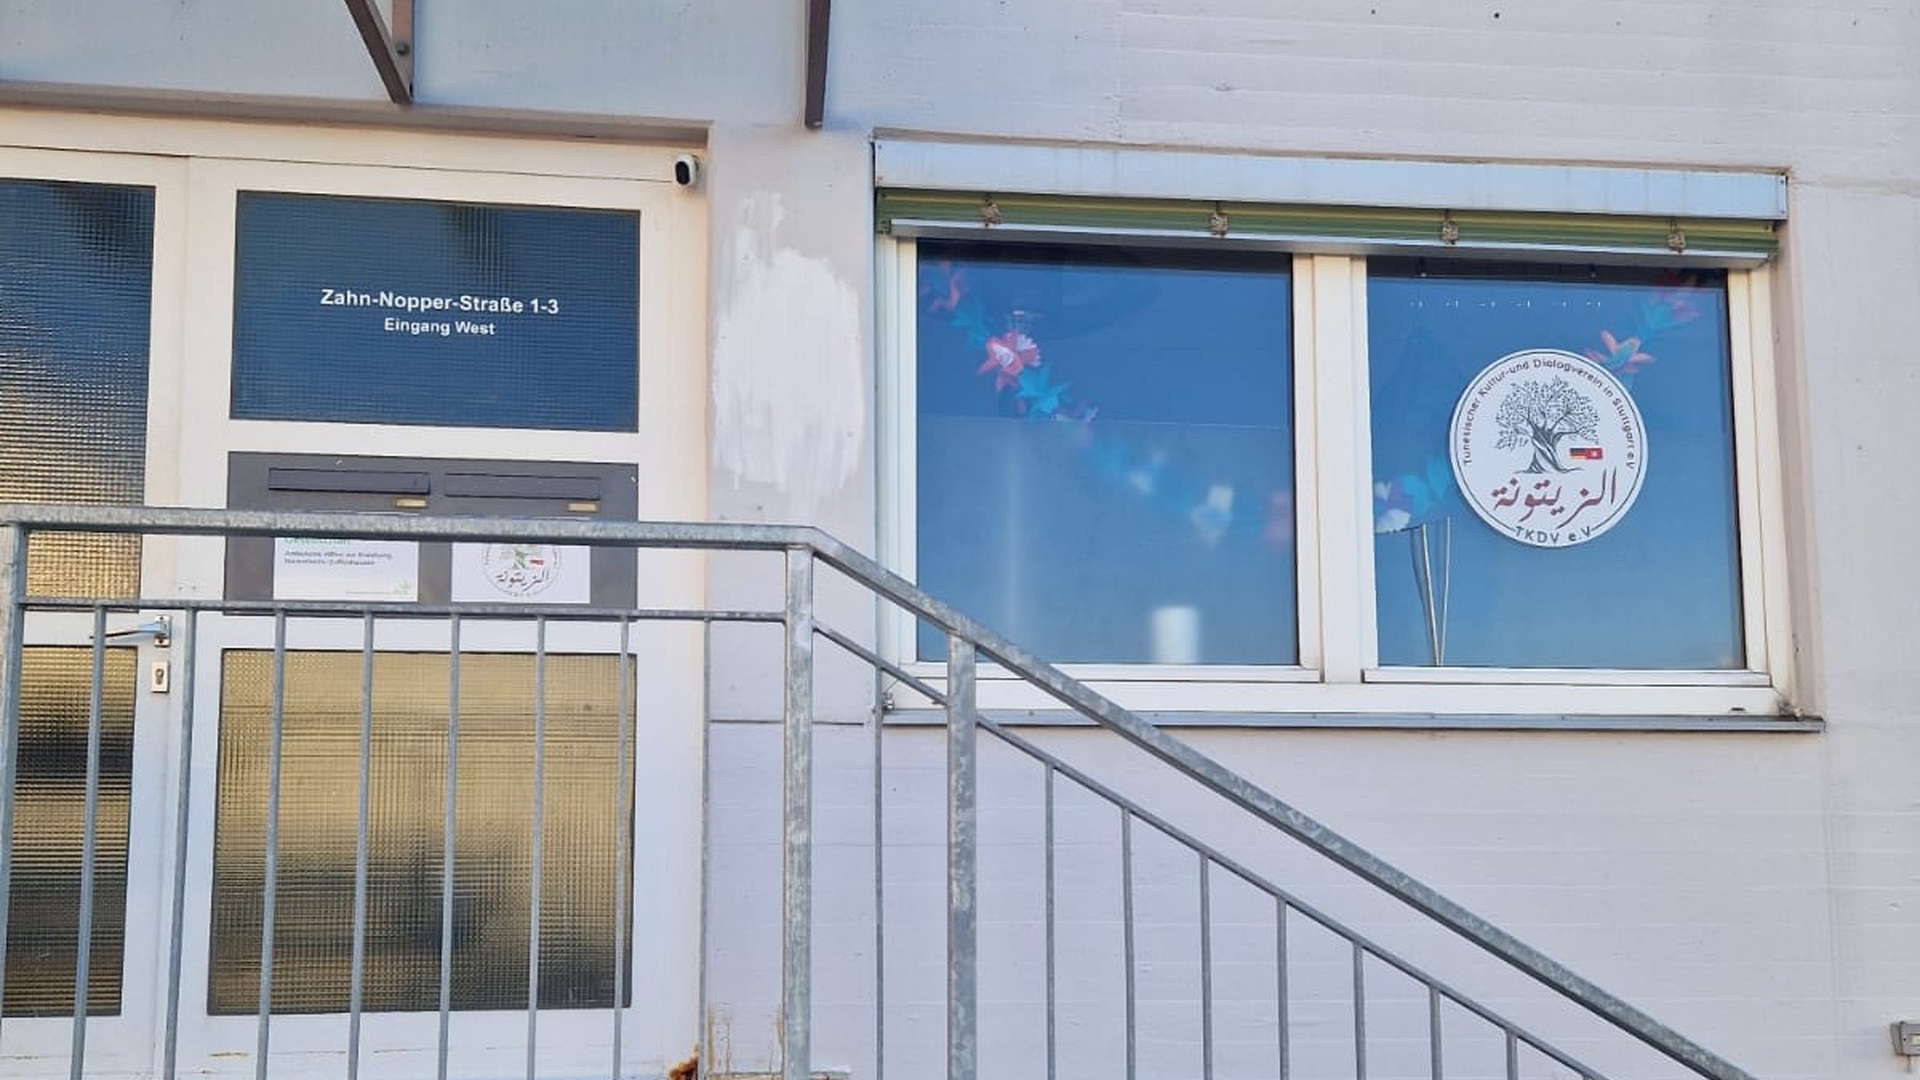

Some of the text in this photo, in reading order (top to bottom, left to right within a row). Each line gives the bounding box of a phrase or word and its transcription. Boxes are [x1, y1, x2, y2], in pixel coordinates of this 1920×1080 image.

[320, 289, 560, 314] Zahn-Nopper-Straße 1-3
[384, 317, 496, 336] Eingang West
[1463, 397, 1481, 465] Tunesischer
[1533, 358, 1603, 388] Dialogverein
[1603, 385, 1614, 398] in
[1491, 467, 1617, 529] الزيتونة
[1515, 525, 1560, 544] TKDV
